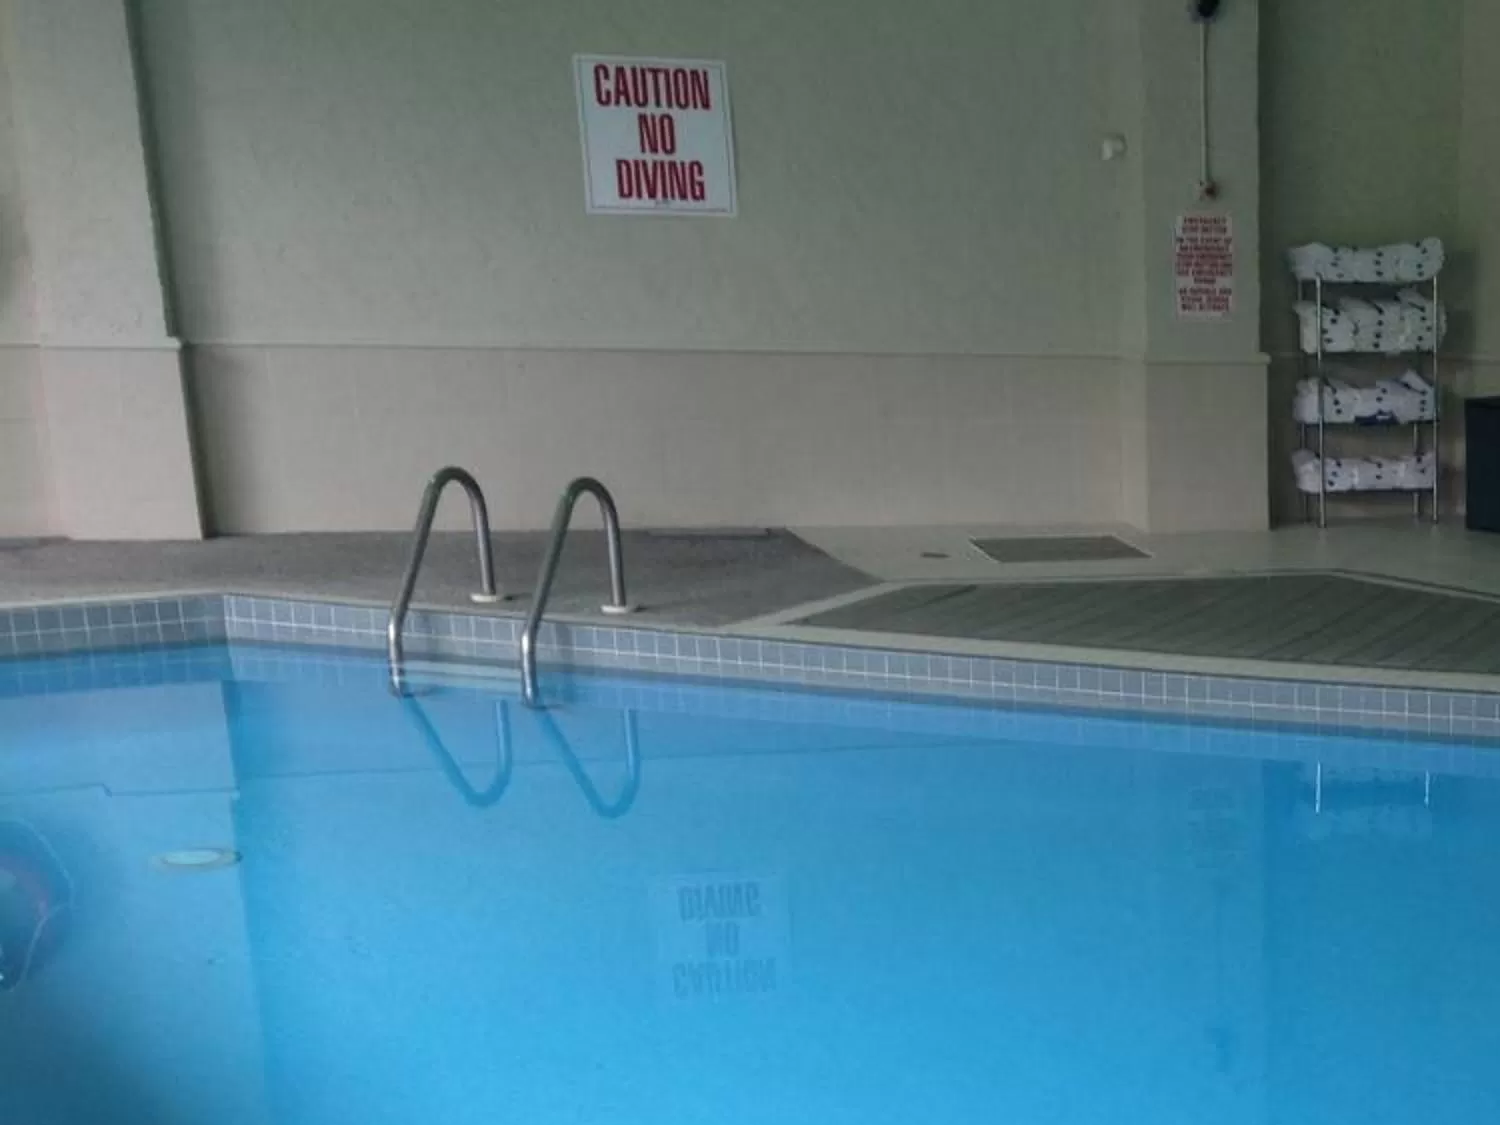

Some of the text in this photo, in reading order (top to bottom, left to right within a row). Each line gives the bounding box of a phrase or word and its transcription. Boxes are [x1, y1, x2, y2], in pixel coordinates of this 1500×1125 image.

[593, 63, 711, 110] CAUTION
[637, 113, 676, 154] NO
[615, 159, 706, 202] DIVING
